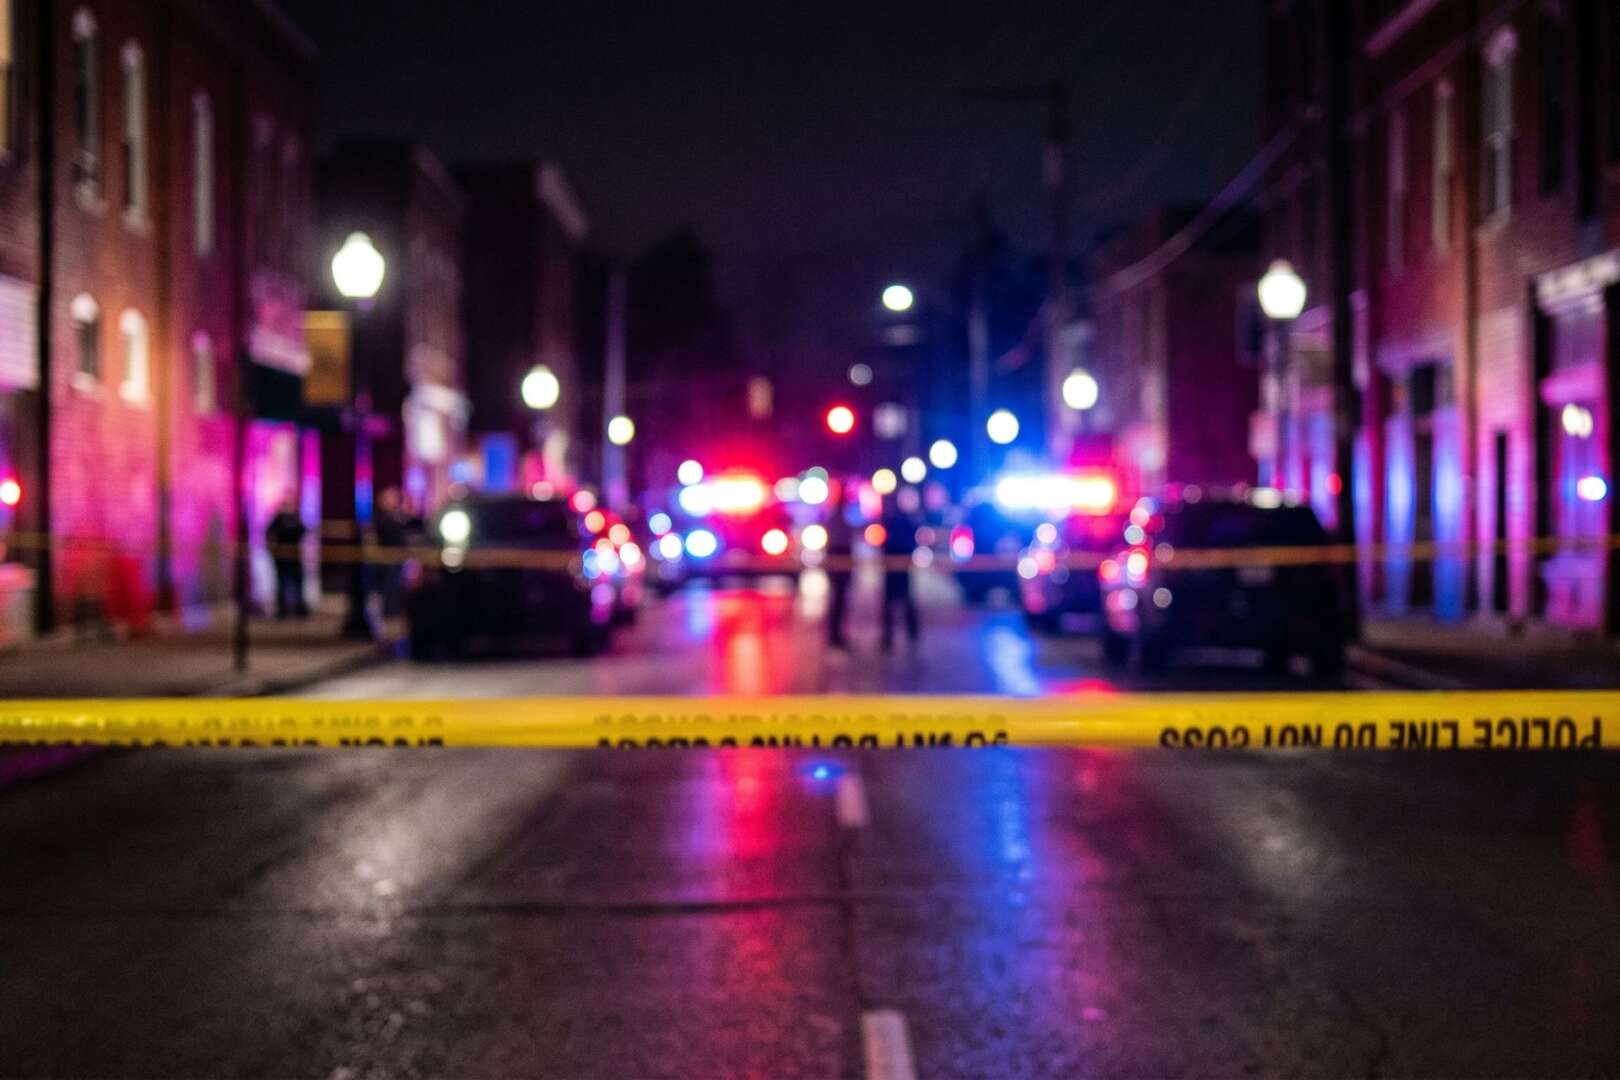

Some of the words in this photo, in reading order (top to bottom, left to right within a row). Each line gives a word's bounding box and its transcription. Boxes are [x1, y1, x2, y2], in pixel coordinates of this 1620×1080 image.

[1334, 722, 1377, 748] DO
[1389, 720, 1459, 748] LINE
[1474, 716, 1602, 748] POLICE
